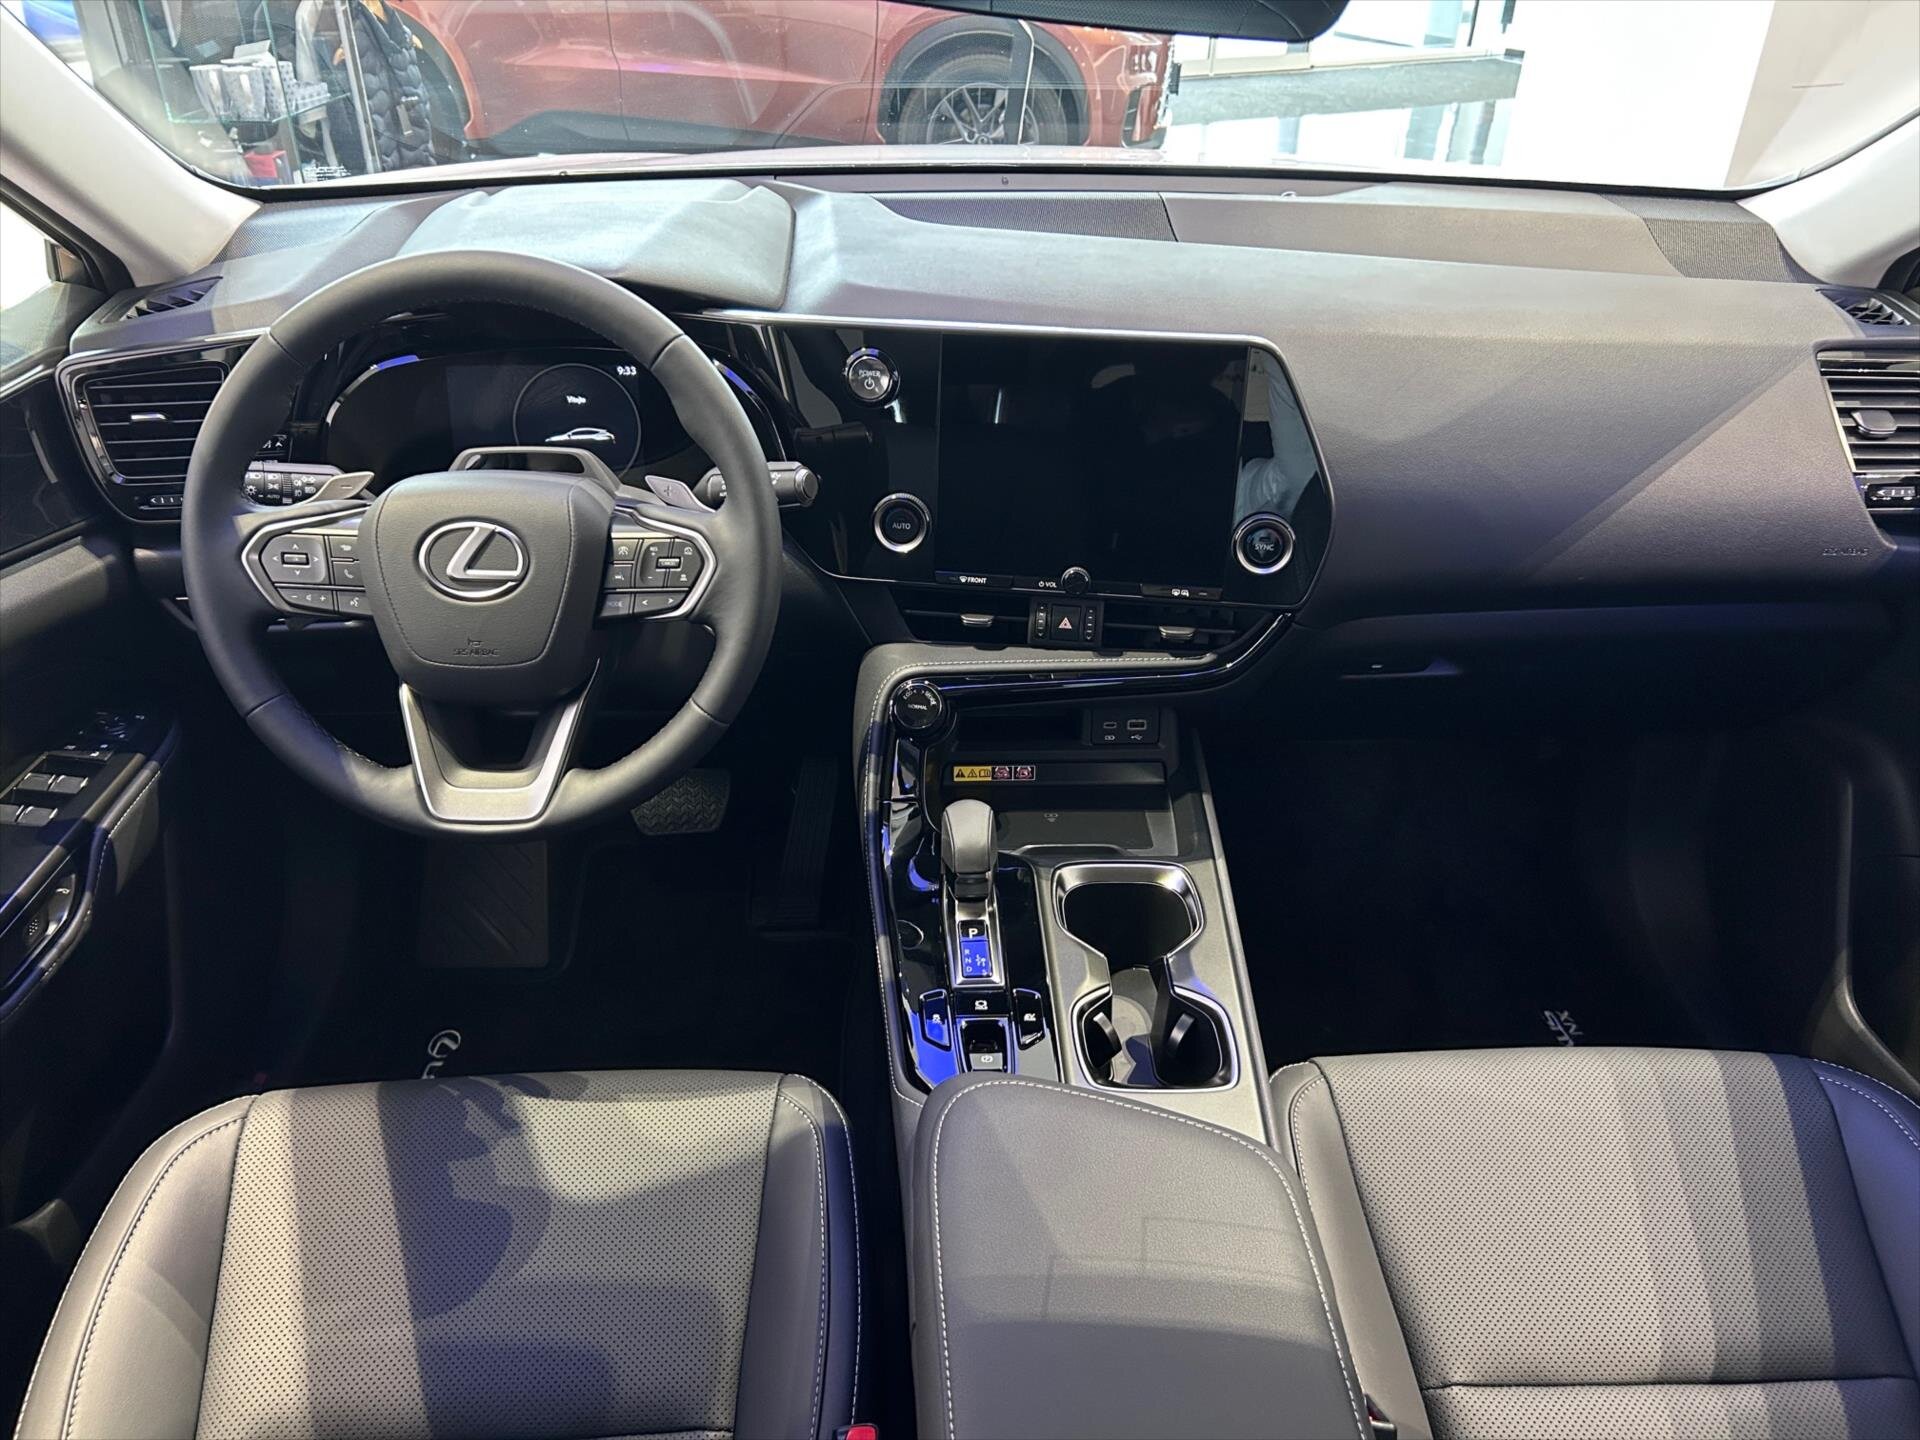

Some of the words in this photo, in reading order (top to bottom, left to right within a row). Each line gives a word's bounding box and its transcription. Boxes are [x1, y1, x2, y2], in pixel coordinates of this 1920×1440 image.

[616, 365, 637, 376] 9:33
[858, 369, 881, 379] POWER
[892, 522, 911, 530] AUTO
[1254, 543, 1275, 551] SYNC
[967, 576, 987, 584] FRONT
[968, 928, 978, 939] P
